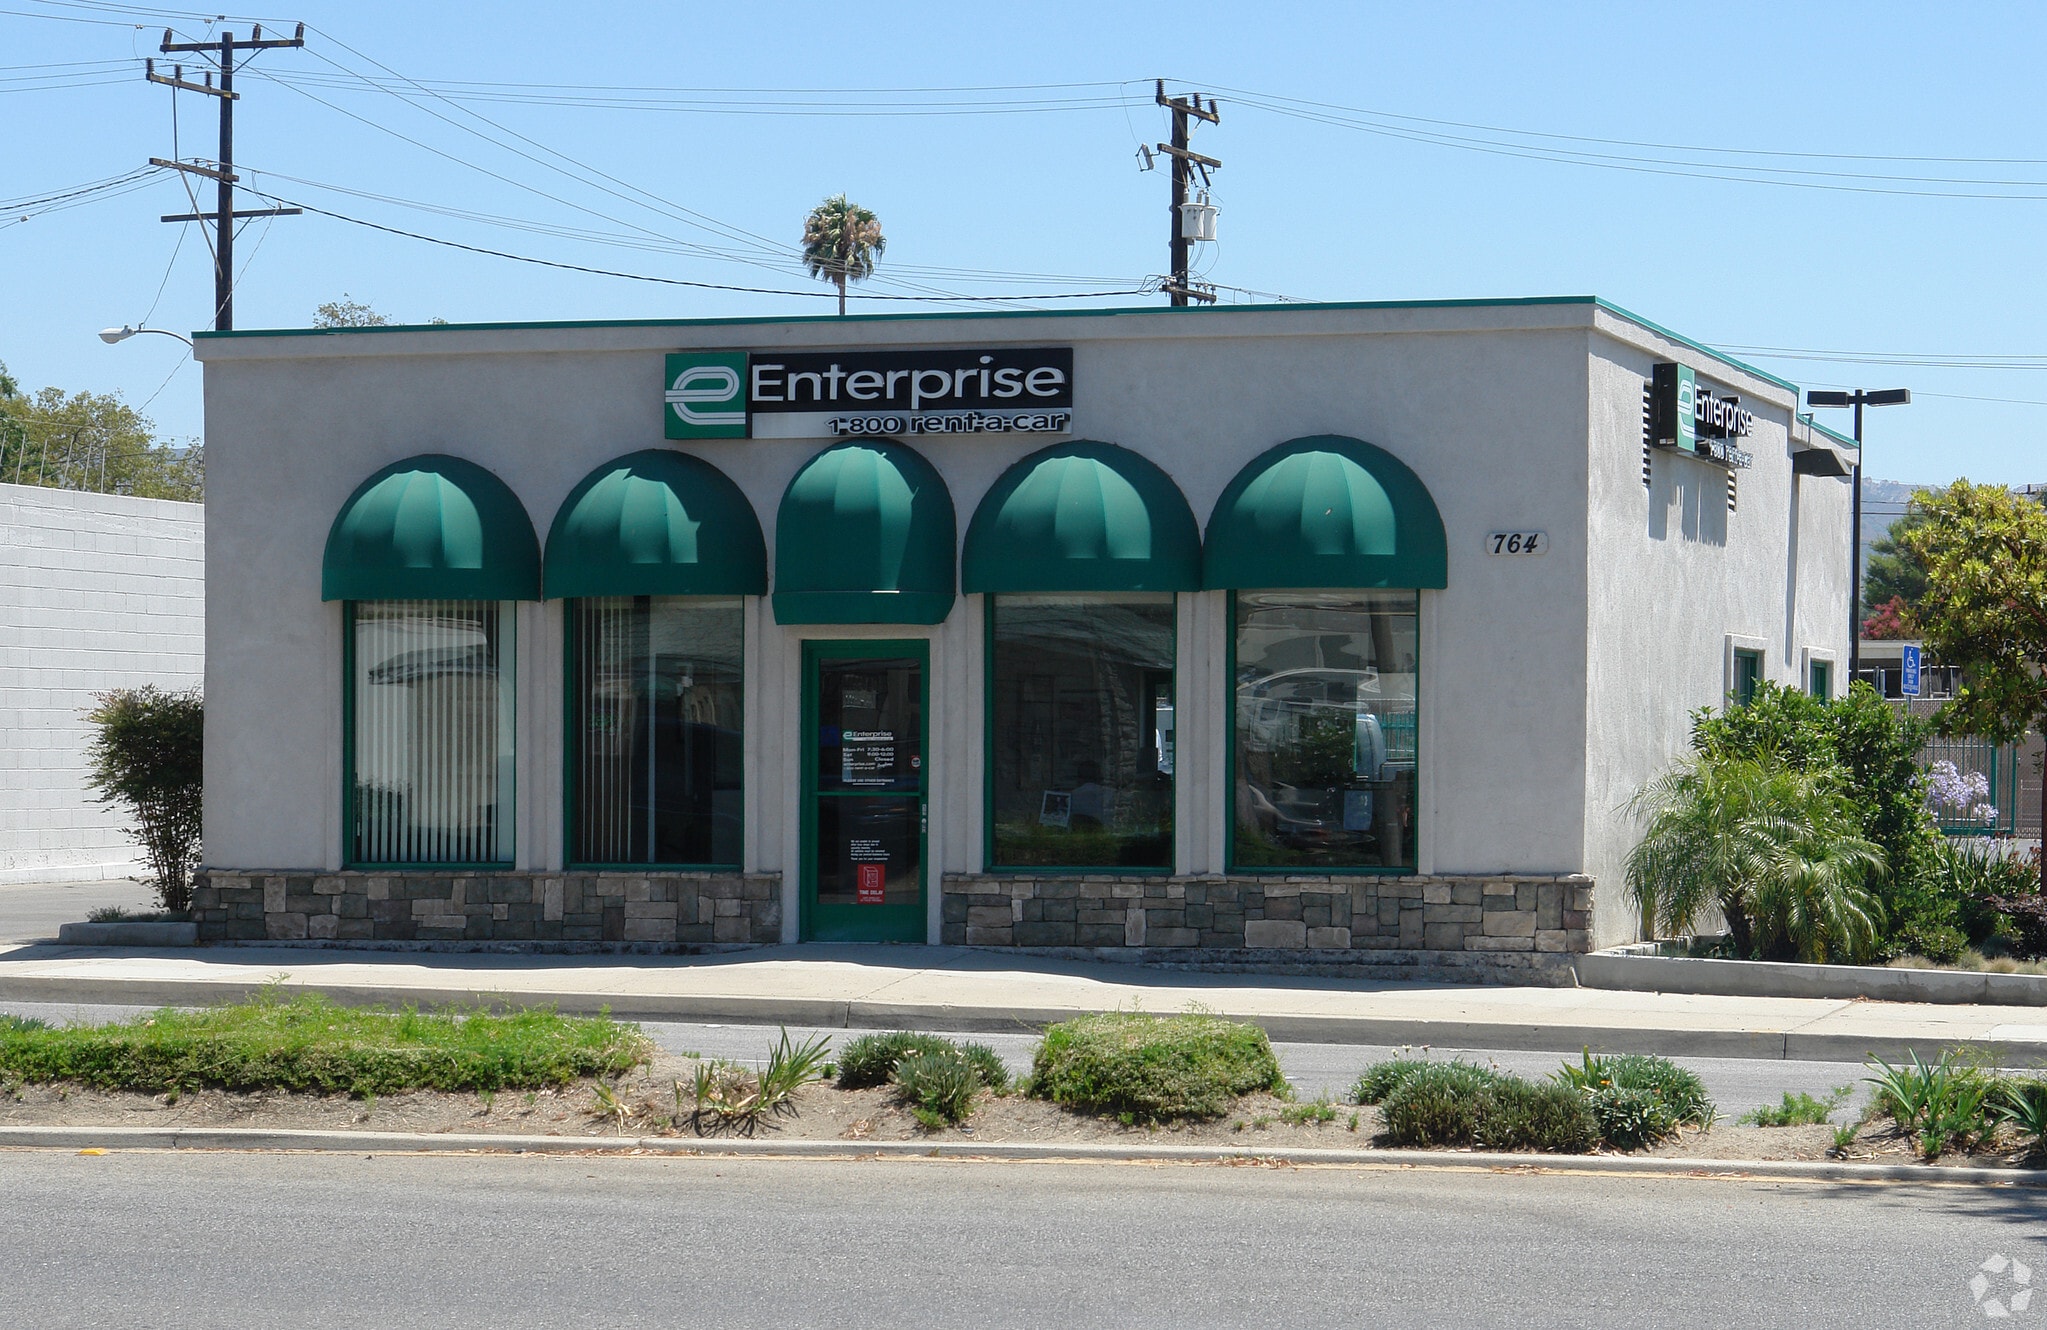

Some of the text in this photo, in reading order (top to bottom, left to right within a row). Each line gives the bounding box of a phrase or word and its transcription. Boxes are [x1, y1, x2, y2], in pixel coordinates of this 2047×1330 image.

[752, 355, 1066, 410] Enterprise
[825, 411, 1071, 435] 1-800 rent-a-car
[1695, 384, 1754, 439] Enterprise
[1494, 533, 1539, 554] 764
[853, 730, 893, 738] Enterprise
